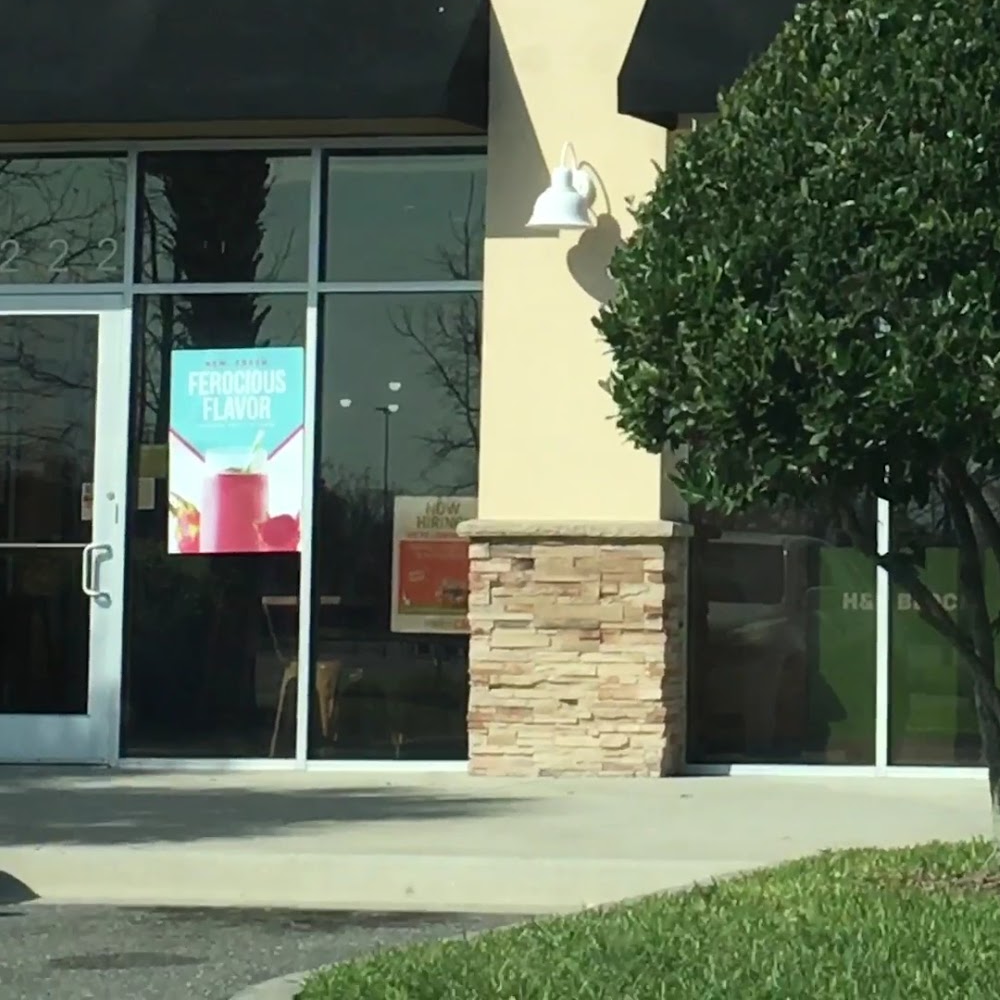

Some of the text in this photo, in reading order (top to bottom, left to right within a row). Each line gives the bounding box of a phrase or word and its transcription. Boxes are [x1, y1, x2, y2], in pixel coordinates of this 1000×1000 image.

[187, 368, 287, 396] FEROCIOUS
[202, 395, 272, 421] FLAVOR
[425, 501, 461, 516] NOW
